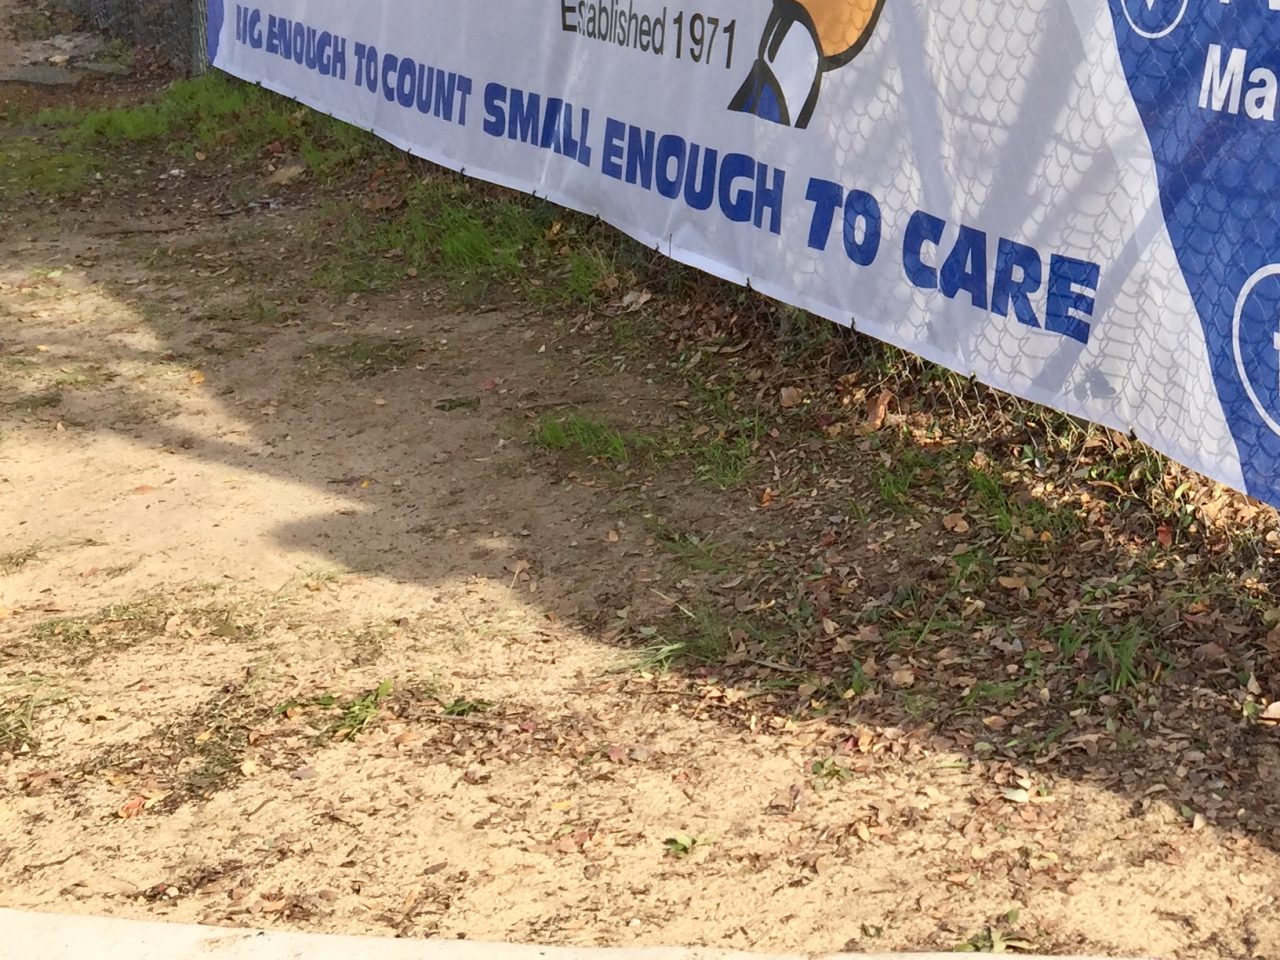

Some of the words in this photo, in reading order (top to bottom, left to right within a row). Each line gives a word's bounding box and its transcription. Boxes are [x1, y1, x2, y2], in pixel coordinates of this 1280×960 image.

[672, 11, 737, 70] 1971
[265, 14, 347, 81] ENOUGH
[354, 41, 379, 94] TO
[381, 53, 473, 127] COUNT
[483, 82, 592, 168] SMALL
[601, 117, 786, 236] ENOUGH
[805, 177, 882, 267] TO
[902, 209, 1101, 346] CARE
